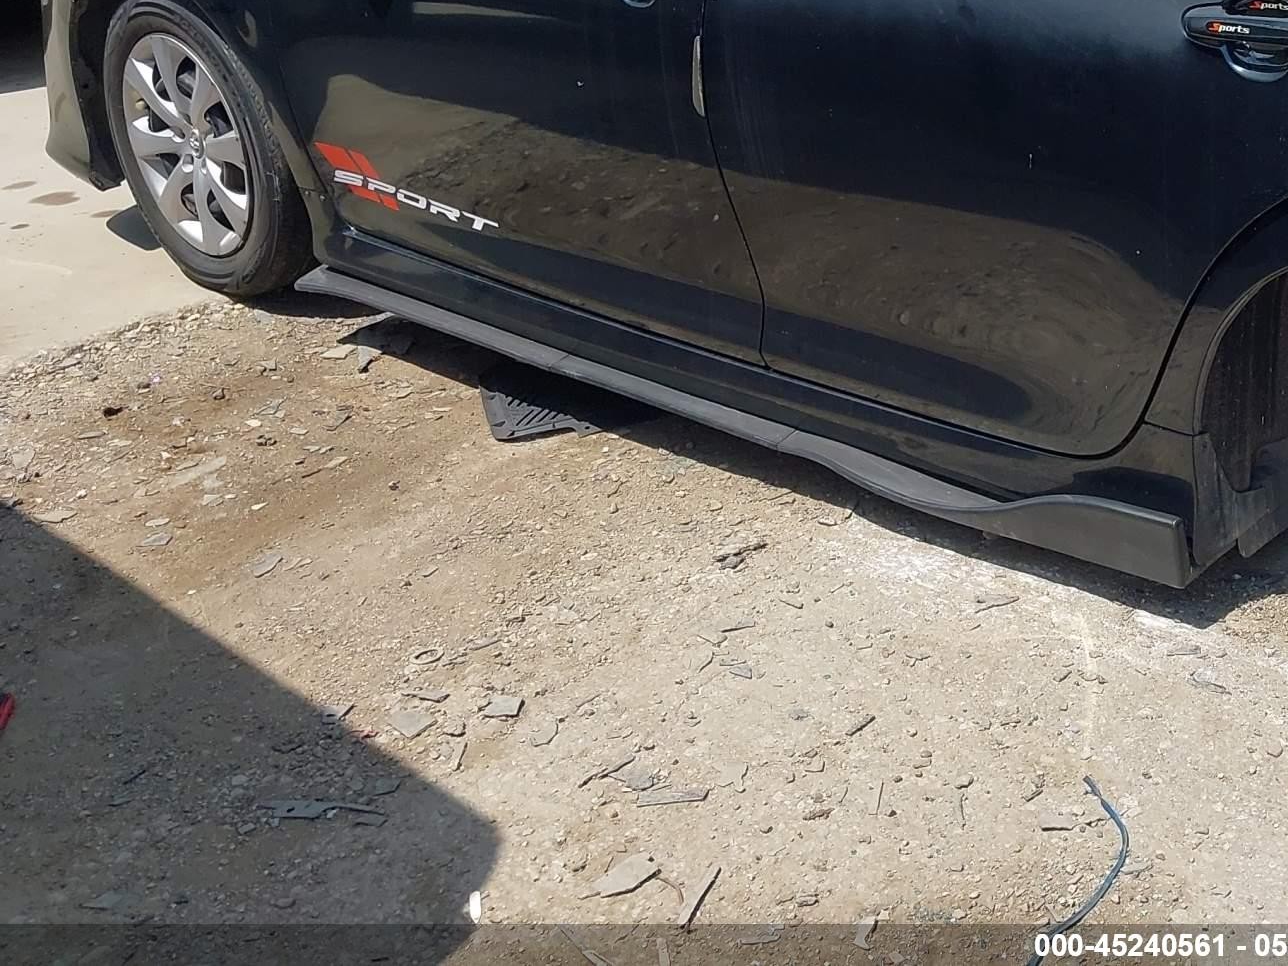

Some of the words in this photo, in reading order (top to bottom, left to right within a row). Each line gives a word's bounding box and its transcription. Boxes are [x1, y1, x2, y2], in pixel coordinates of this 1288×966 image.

[1249, 1, 1288, 10] Sports
[1208, 23, 1250, 34] Sports
[334, 169, 499, 231] SPORT
